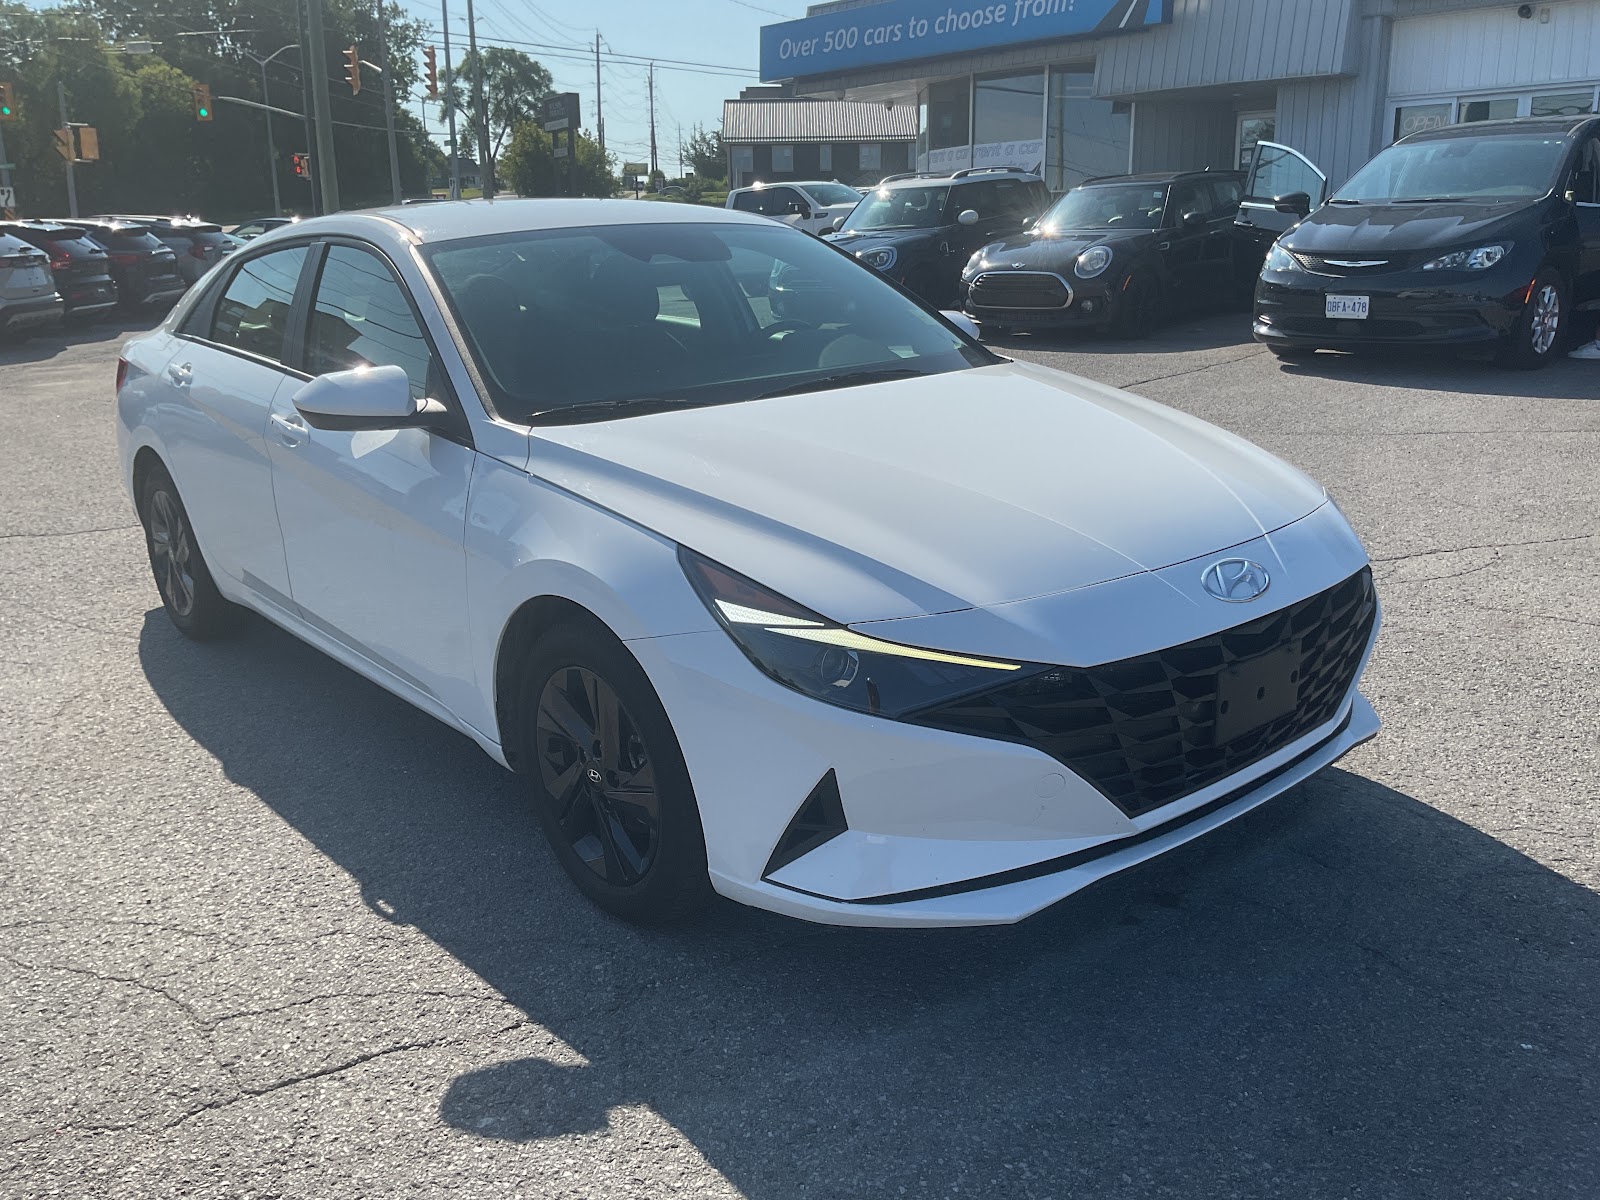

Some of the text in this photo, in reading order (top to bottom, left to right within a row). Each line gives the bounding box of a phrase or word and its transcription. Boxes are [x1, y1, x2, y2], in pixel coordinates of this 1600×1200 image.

[779, 37, 819, 60] Over
[822, 26, 859, 53] 500
[863, 23, 903, 46] cars
[908, 16, 928, 39] to
[934, 8, 1007, 34] choose
[1403, 115, 1447, 132] OPEN
[1004, 144, 1015, 156] a
[1018, 142, 1042, 155] car
